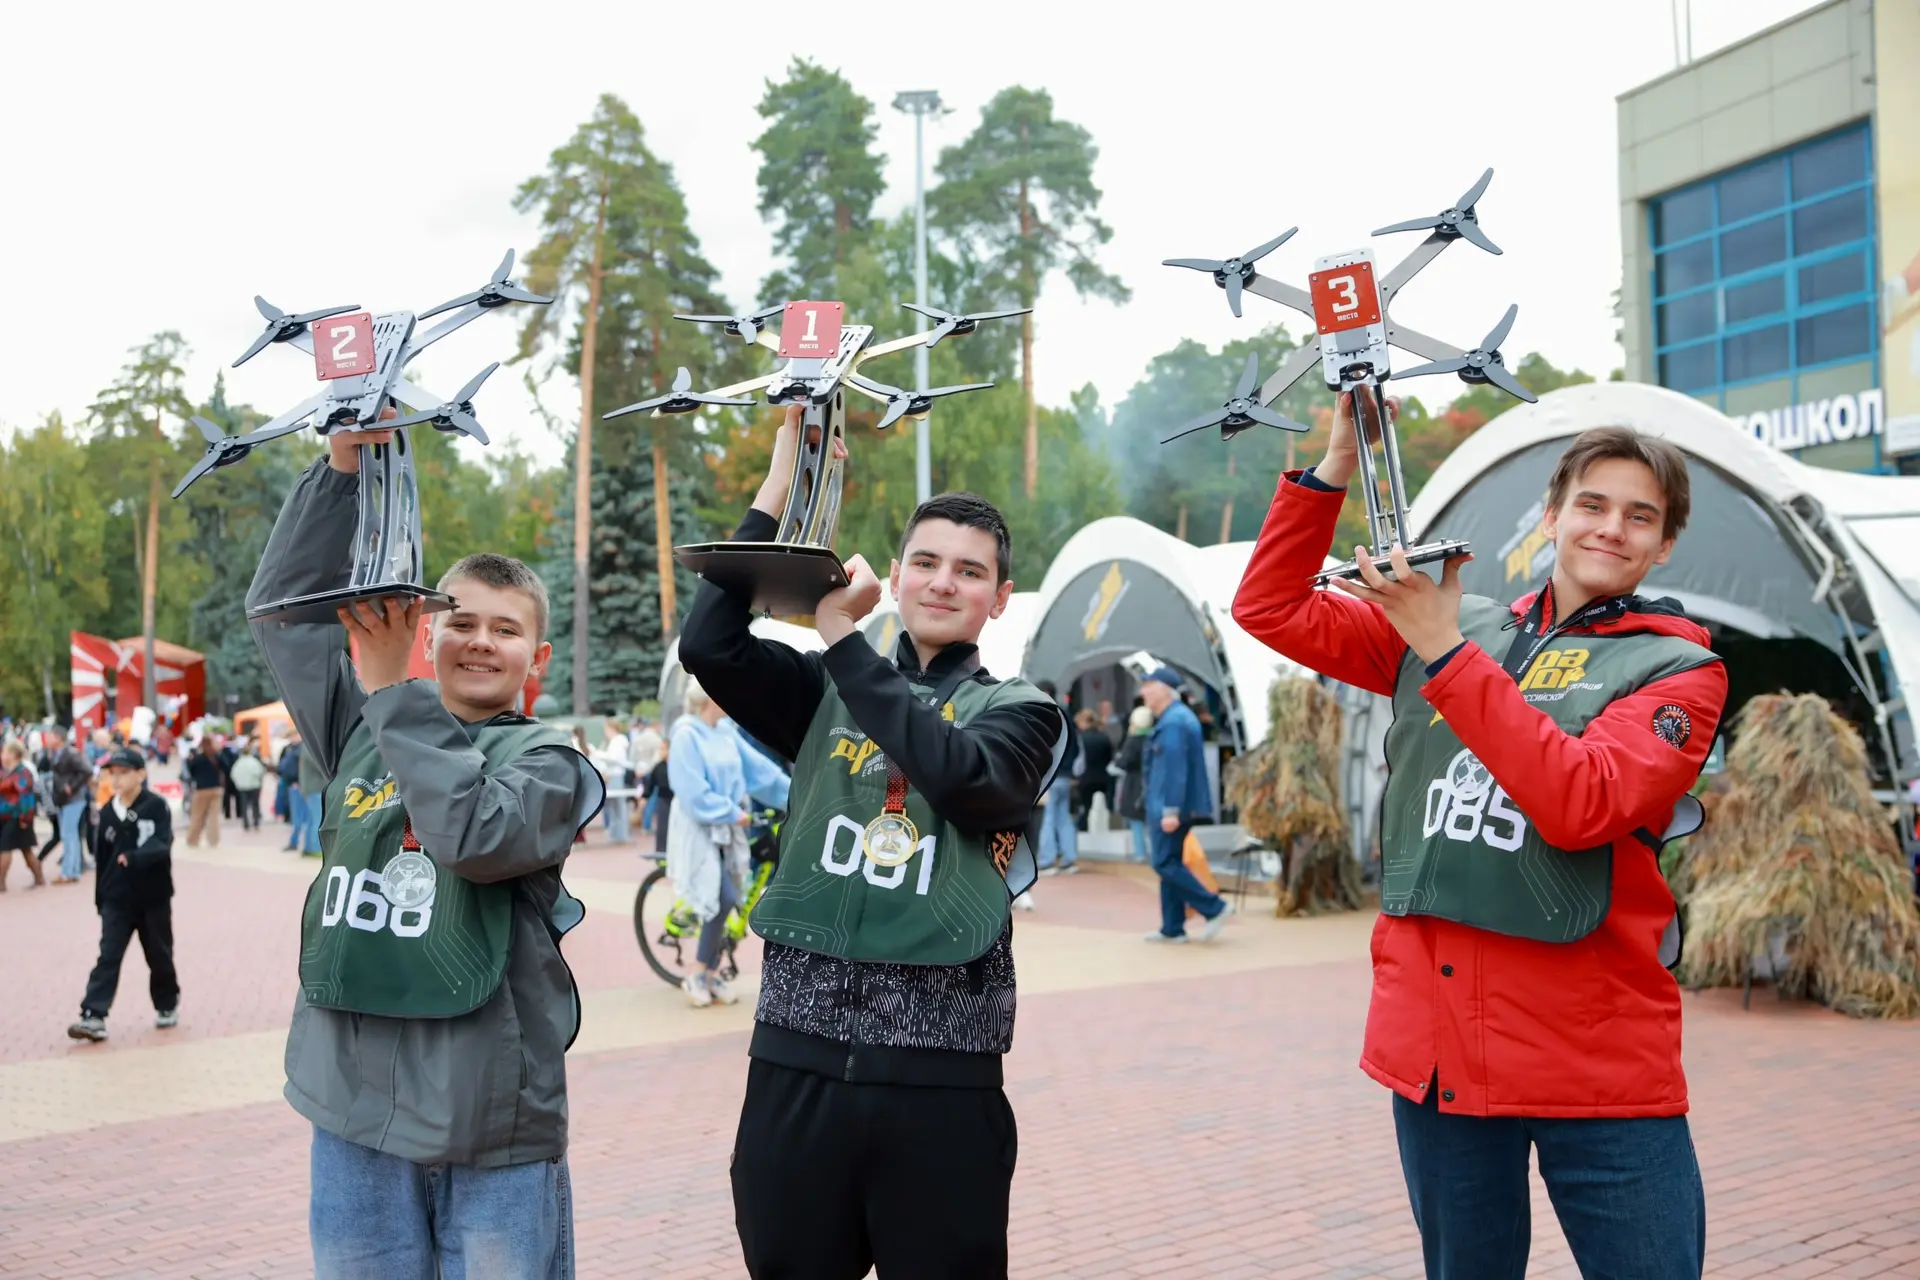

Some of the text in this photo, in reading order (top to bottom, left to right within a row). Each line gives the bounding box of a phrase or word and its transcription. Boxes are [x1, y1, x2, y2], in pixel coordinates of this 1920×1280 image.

[1328, 275, 1359, 313] 3
[331, 326, 358, 360] 2
[801, 310, 818, 341] 1
[1734, 388, 1884, 450] ОШКОЛ
